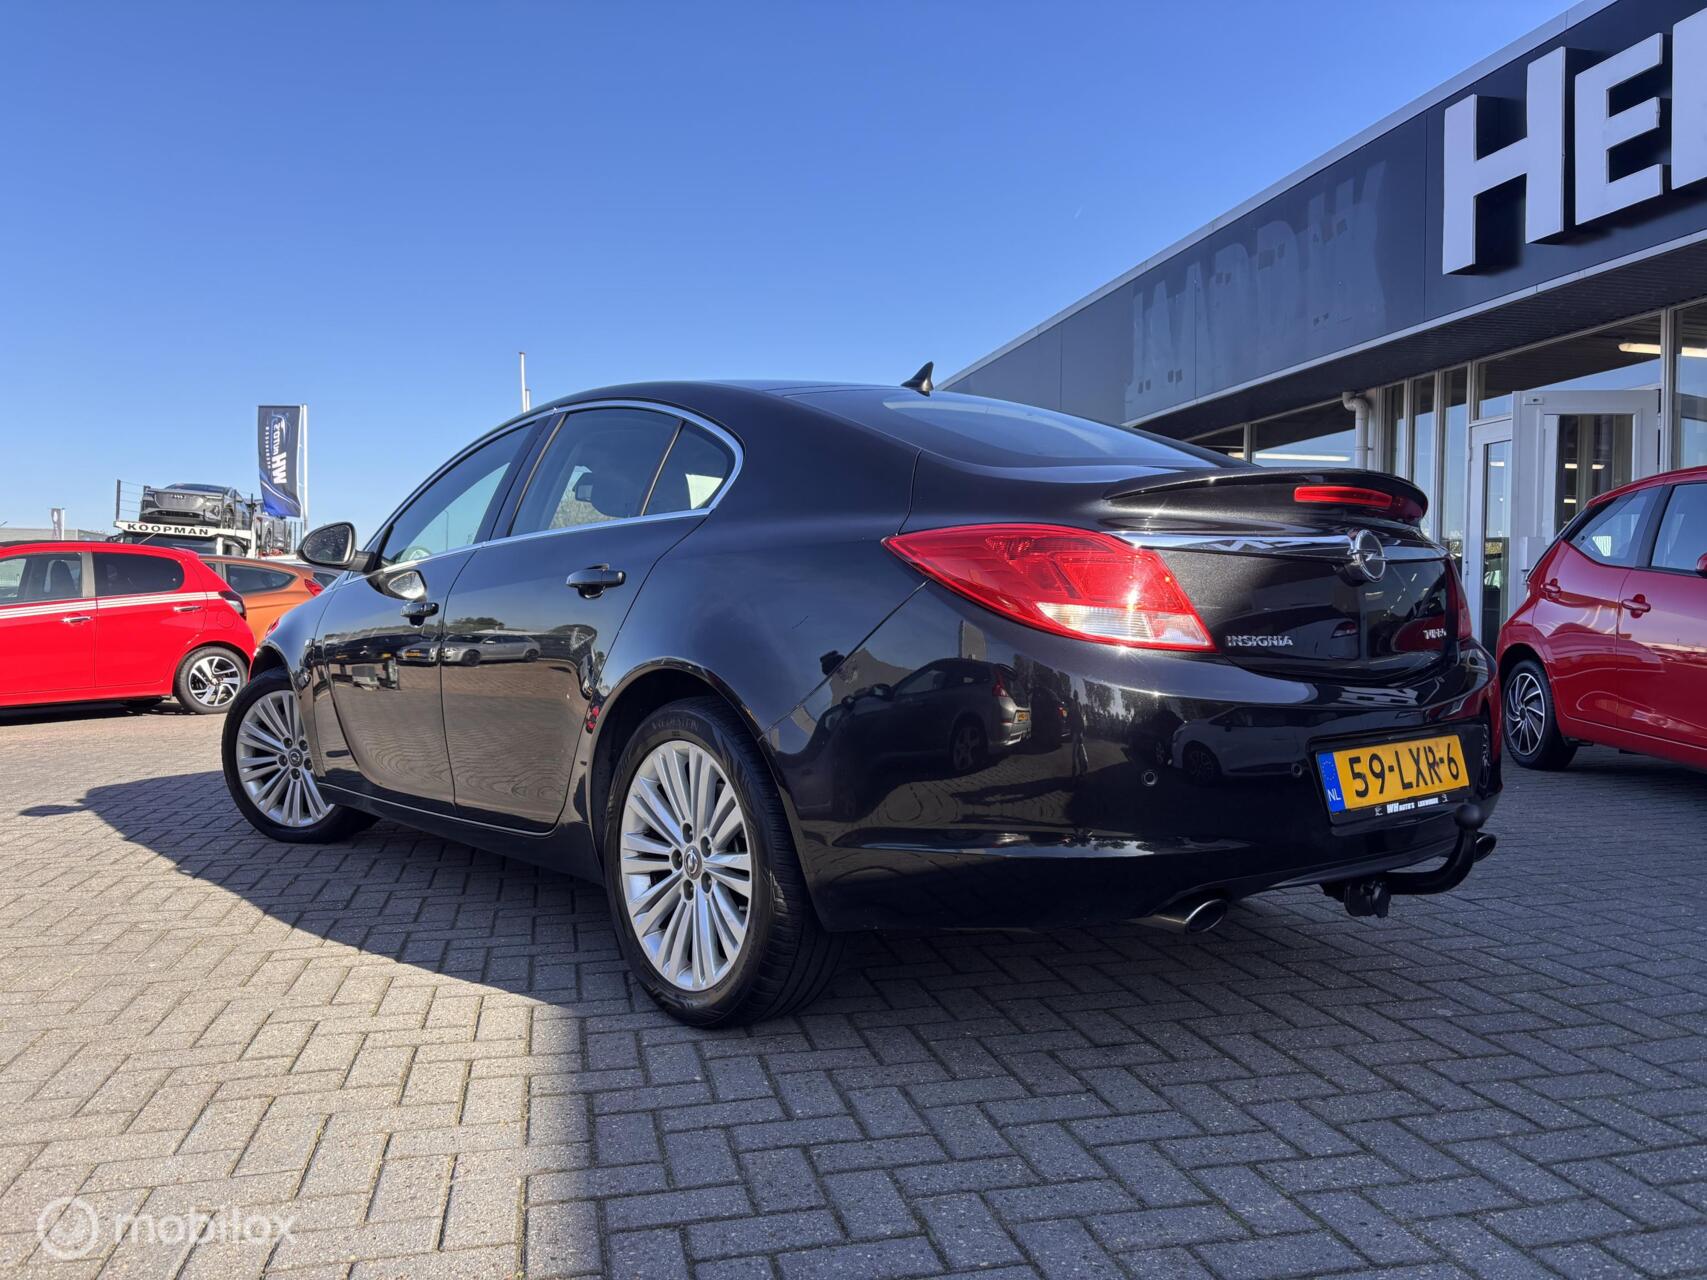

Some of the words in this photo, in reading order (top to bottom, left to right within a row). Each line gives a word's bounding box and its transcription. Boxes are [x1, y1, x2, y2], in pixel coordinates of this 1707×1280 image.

[127, 523, 209, 536] KOOPMAN
[1224, 635, 1294, 647] INSIGNIA
[1348, 742, 1460, 798] 59-LXR-6
[1327, 789, 1342, 801] NL
